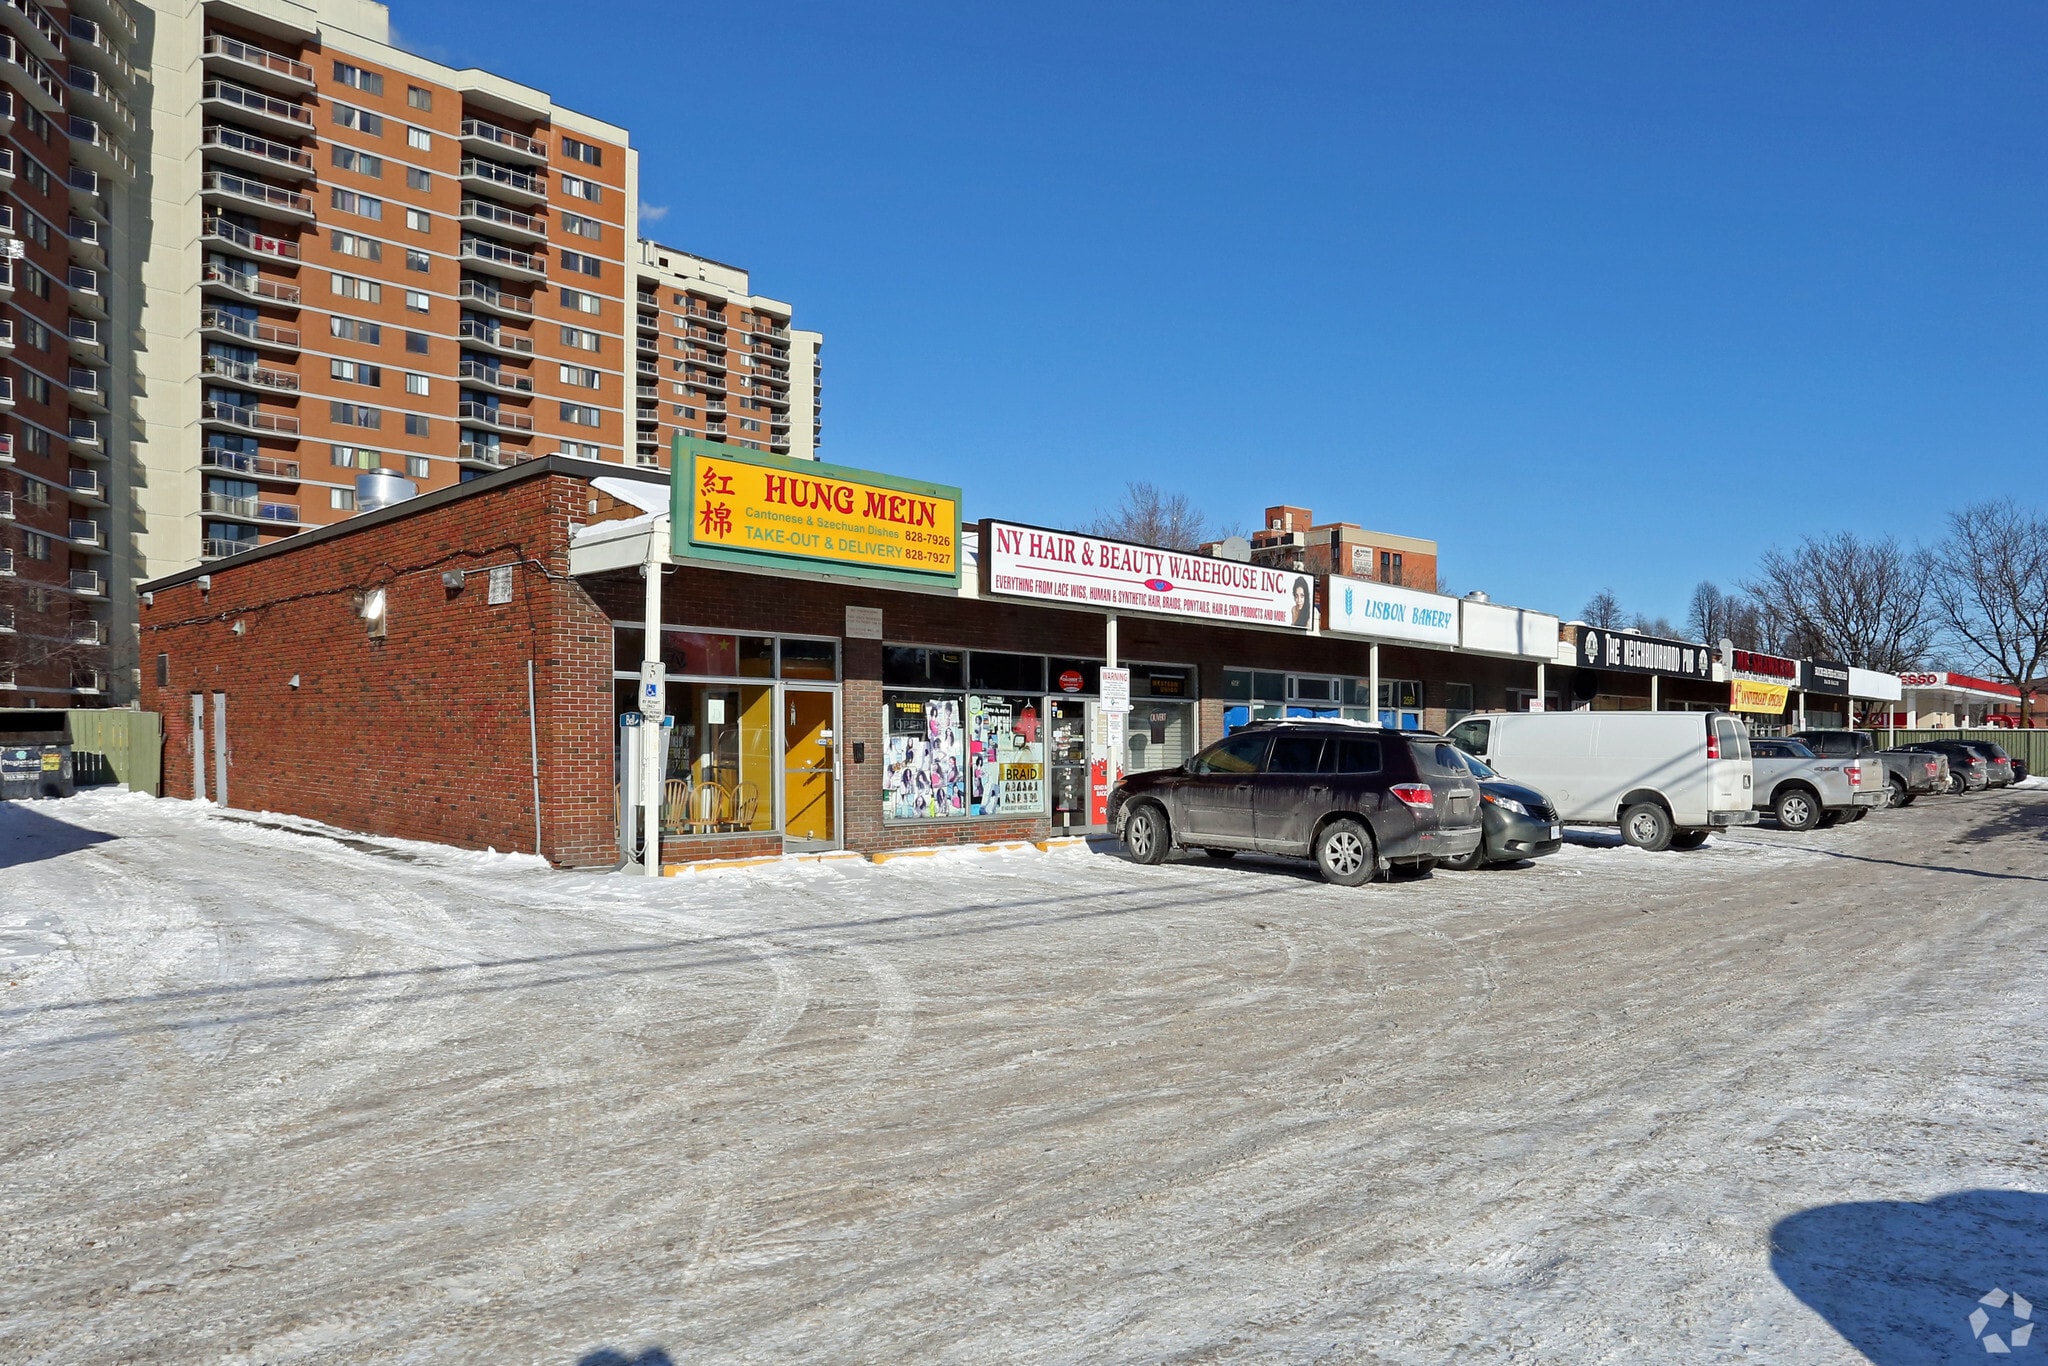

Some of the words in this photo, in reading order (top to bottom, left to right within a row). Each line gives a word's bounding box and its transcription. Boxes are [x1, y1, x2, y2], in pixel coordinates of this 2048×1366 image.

[700, 466, 736, 539] 紅棉
[764, 473, 854, 515] HUNG
[863, 491, 937, 528] MEIN
[745, 507, 804, 525] Cantonese
[806, 515, 814, 526] &
[817, 517, 865, 533] Szechuan
[868, 525, 899, 539] Dishes
[905, 530, 951, 546] 828-7926
[744, 526, 820, 548] TAKE-OUT
[824, 537, 833, 550] &
[839, 538, 902, 558] DELIVERY
[905, 549, 951, 564] 828-7927
[996, 528, 1024, 555] NY
[1029, 533, 1076, 564] HAIR
[1082, 541, 1094, 567] &
[1100, 544, 1164, 575] BEAUTY
[1168, 555, 1257, 590] WAREHOUSE
[1261, 571, 1286, 594] INC.
[995, 577, 1033, 593] EVERYTHING
[1035, 579, 1052, 595] FROM
[1054, 582, 1069, 597] LACE
[1070, 584, 1088, 600] WIGS,
[1089, 587, 1111, 602] HUMAN
[1112, 590, 1117, 603] &
[1118, 590, 1147, 606] SYNTHETIC
[1148, 594, 1161, 609] HAIR,
[1163, 596, 1182, 611] BRAIDS,
[1183, 599, 1211, 615] PONYTAILS,
[1212, 602, 1223, 615] HAIR
[1224, 604, 1228, 616] &
[1229, 604, 1239, 617] SKIN
[1241, 606, 1263, 619] PRODUCTS
[1264, 608, 1273, 620] AND
[1274, 610, 1286, 622] MORE
[1365, 599, 1406, 622] LISBON
[1412, 607, 1452, 629] BAKERY
[1624, 640, 1680, 672] NEIGHBOURHOOD
[1682, 648, 1694, 673] PUB
[1103, 672, 1128, 682] WARNING
[1900, 674, 1937, 684] ESSO
[625, 714, 635, 726] Bell
[895, 720, 924, 730] OPEN
[1006, 768, 1037, 780] BRAID
